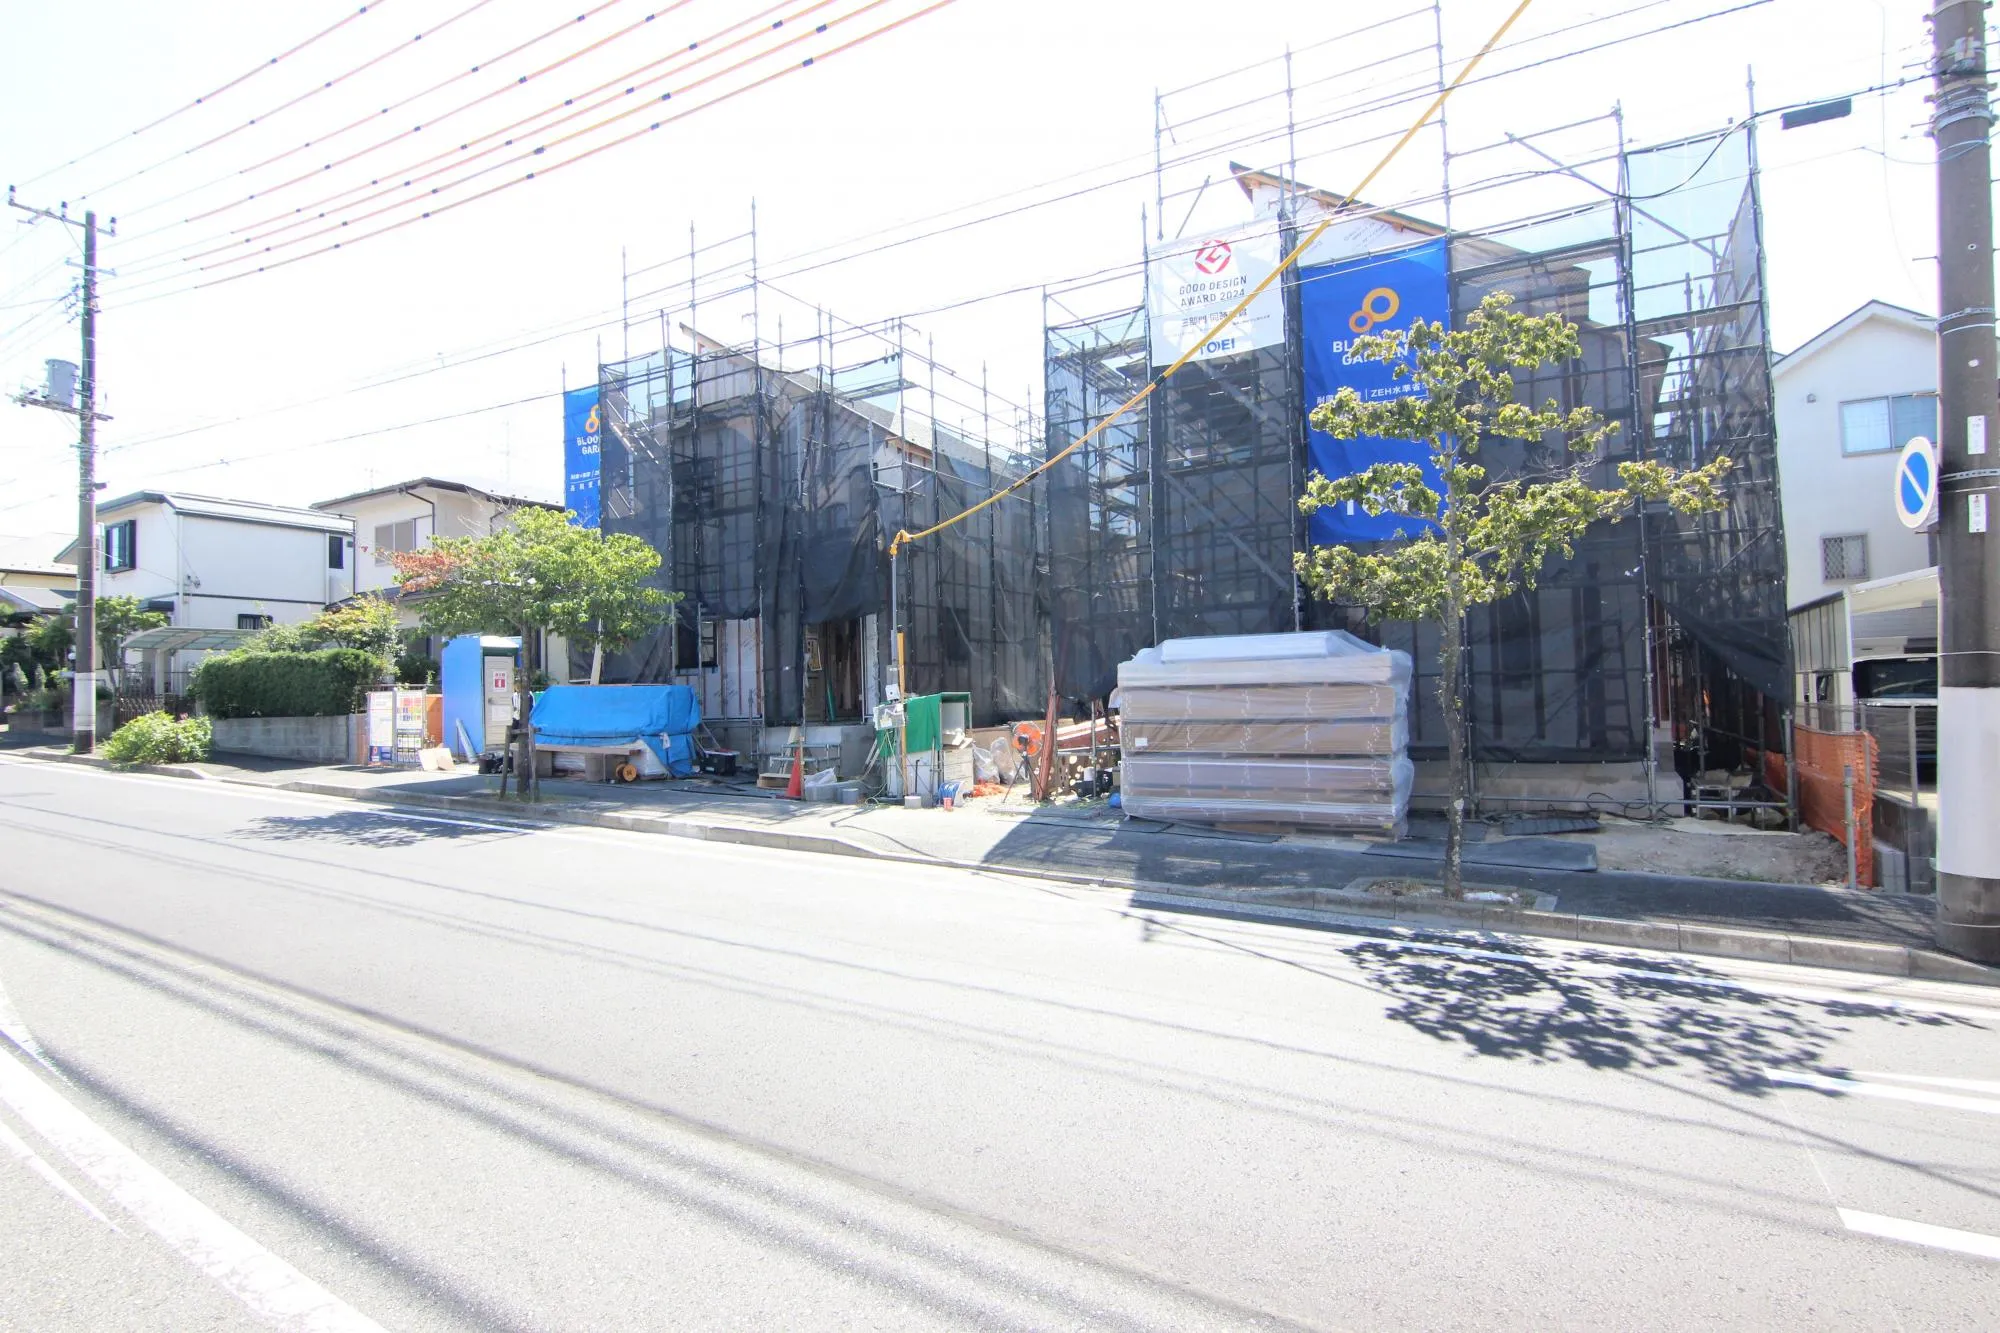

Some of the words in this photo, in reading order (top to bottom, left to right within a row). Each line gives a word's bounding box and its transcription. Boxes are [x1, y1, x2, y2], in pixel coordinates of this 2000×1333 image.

[1180, 282, 1206, 295] GOOD
[1209, 275, 1247, 291] DESIGN
[1181, 293, 1217, 307] AWARD
[1220, 288, 1245, 301] 2024
